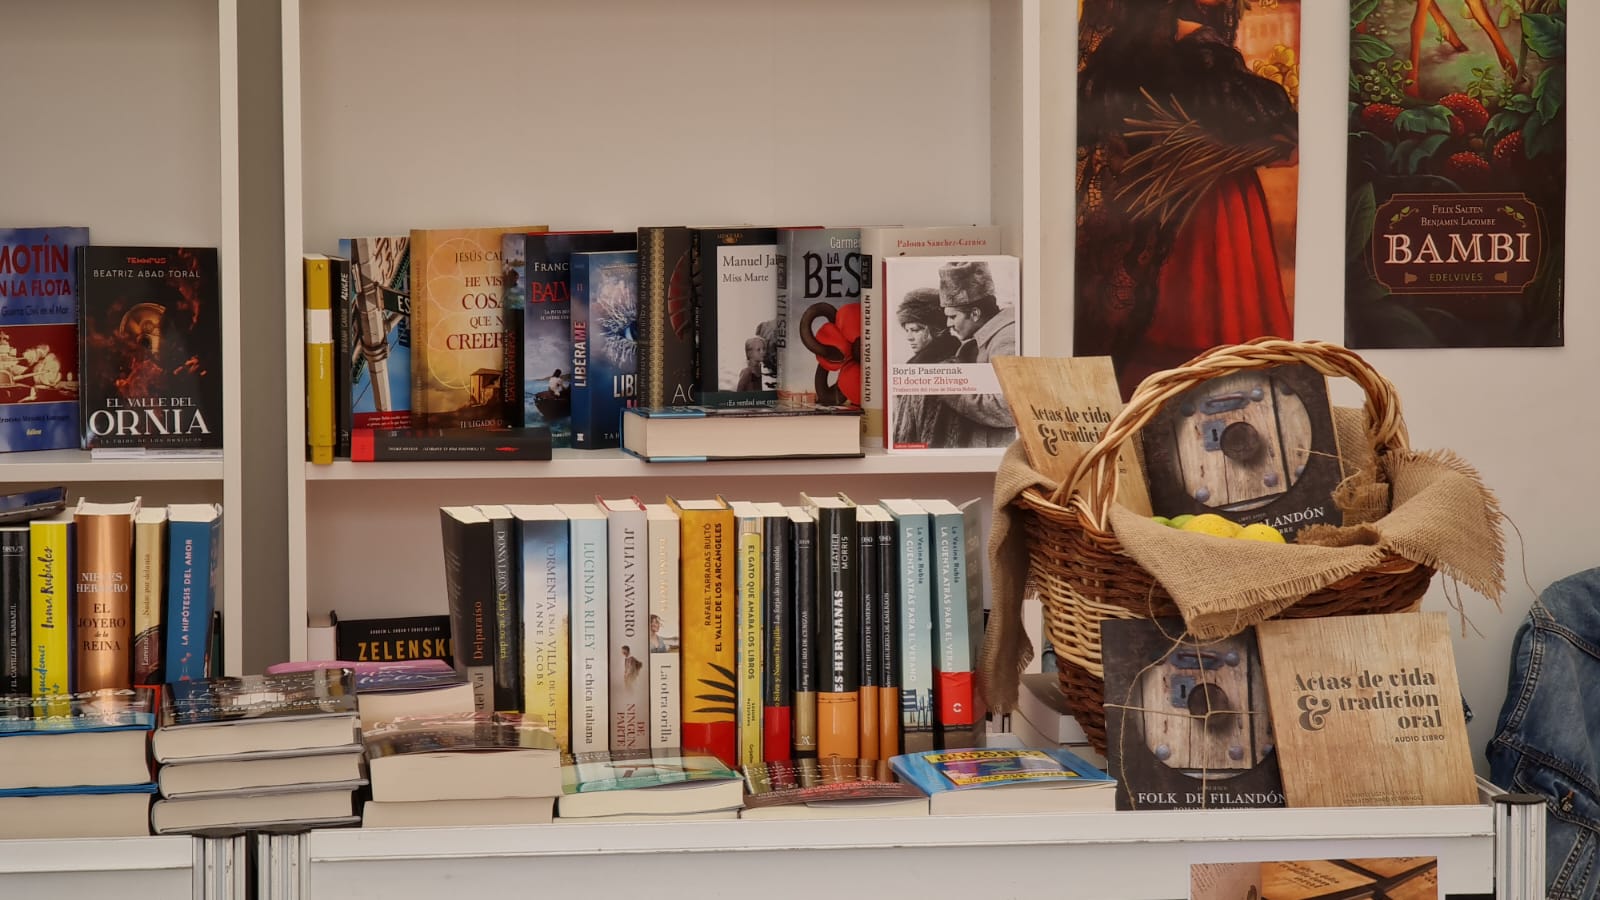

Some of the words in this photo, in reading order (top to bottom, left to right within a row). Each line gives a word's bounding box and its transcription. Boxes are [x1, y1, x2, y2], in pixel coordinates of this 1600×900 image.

[1432, 204, 1454, 214] FELIX
[1455, 204, 1484, 214] SALTEN
[1421, 217, 1459, 228] BENJAMIN
[1461, 217, 1496, 226] LACOMBE
[897, 239, 926, 248] Paloma
[1384, 233, 1531, 264] BAMBI
[455, 250, 482, 263] JESÚS
[723, 253, 762, 267] Manuel
[826, 252, 840, 265] LA
[93, 269, 134, 278] BEATRIZ
[137, 269, 164, 278] ABAD
[168, 269, 201, 278] TORAL
[465, 276, 481, 287] HE
[723, 273, 743, 283] Miss
[744, 272, 769, 282] Marte
[802, 250, 861, 299] BES
[1429, 271, 1483, 282] EDELVIVES
[11, 280, 28, 297] LA
[31, 279, 72, 297] FLOTA
[863, 294, 872, 326] BERLÍN
[470, 316, 491, 329] QUE
[776, 294, 787, 349] BESTIA
[863, 329, 872, 341] EN
[574, 321, 587, 387] LIBÉRAME
[863, 343, 872, 363] DÍAS
[893, 367, 916, 376] Boris
[918, 366, 963, 375] Pasternak
[893, 376, 902, 385] El
[904, 376, 932, 385] doctor
[934, 376, 969, 386] Zhivago
[106, 398, 123, 407] EL
[128, 397, 167, 407] VALLE
[171, 396, 197, 407] DEL
[89, 408, 212, 436] ORNIA
[1030, 403, 1064, 424] Actas
[1064, 405, 1081, 423] de
[1082, 405, 1112, 424] vida
[1060, 426, 1104, 444] tradici
[702, 523, 712, 550] BULTÓ
[905, 527, 914, 538] LA
[917, 526, 924, 535] La
[941, 526, 949, 537] LA
[951, 526, 958, 535] La
[183, 539, 194, 566] AMOR
[496, 531, 507, 564] DONNA
[623, 528, 635, 569] JULIA
[713, 523, 722, 580] ARCÁNGELES
[747, 545, 755, 554] EL
[773, 545, 781, 571] rebelde
[831, 533, 840, 573] HEATHER
[841, 535, 849, 570] MORRIS
[906, 540, 915, 575] CUENTA
[917, 537, 925, 561] Vecina
[941, 539, 950, 574] CUENTA
[951, 536, 959, 560] Vecina
[37, 546, 54, 595] Rubiales
[182, 568, 192, 585] DEL
[497, 565, 507, 591] LEON
[583, 542, 595, 604] LUCINDA
[704, 552, 712, 593] TARRADAS
[747, 557, 755, 579] GATO
[917, 563, 925, 584] Rubia
[953, 562, 961, 583] Rubia
[773, 572, 781, 586] una
[746, 581, 755, 599] QUE
[773, 587, 781, 596] de
[907, 577, 916, 604] ATRÁS
[943, 576, 952, 604] ATRÁS
[93, 603, 110, 613] EL
[180, 587, 192, 632] HIPÓTESIS
[497, 593, 508, 611] Dad
[624, 573, 636, 638] NAVARRO
[704, 595, 712, 626] RAFAEL
[715, 601, 722, 612] DE
[773, 597, 782, 613] forja
[864, 594, 872, 624] EMERSON
[41, 597, 55, 629] Inma
[77, 617, 126, 629] JOYERO
[536, 602, 544, 636] ANNE
[547, 614, 555, 625] EN
[747, 600, 755, 629] AMABA
[773, 614, 781, 624] La
[908, 607, 916, 629] PARA
[944, 607, 952, 629] PARA
[181, 634, 190, 646] LA
[547, 627, 555, 637] LA
[584, 609, 596, 650] RILEY
[747, 631, 755, 648] LOS
[834, 590, 844, 672] HERMANAS
[908, 632, 916, 641] EL
[945, 632, 952, 641] EL
[11, 638, 17, 647] DE
[83, 640, 121, 651] REINA
[141, 637, 150, 666] Lorenzo
[357, 638, 447, 661] ZELENSK
[715, 642, 722, 652] EL
[536, 642, 545, 687] JACOBS
[546, 640, 557, 676] VILLA
[585, 657, 595, 670] La
[747, 650, 755, 680] LIBROS
[474, 672, 485, 689] Val
[660, 664, 671, 680] La
[1295, 673, 1352, 691] Actas
[1358, 669, 1384, 689] de
[1389, 667, 1436, 687] vida
[585, 673, 595, 701] chica
[660, 683, 671, 708] otra
[474, 692, 485, 710] del
[1338, 689, 1439, 711] tradicion
[585, 705, 595, 744] italiana
[636, 721, 646, 736] DE
[659, 711, 672, 743] orilla
[1398, 708, 1443, 729] oral
[616, 712, 626, 747] PARTE
[1395, 736, 1420, 744] AUDIO
[1423, 734, 1445, 742] LIBRO
[1137, 793, 1177, 804] FOLK
